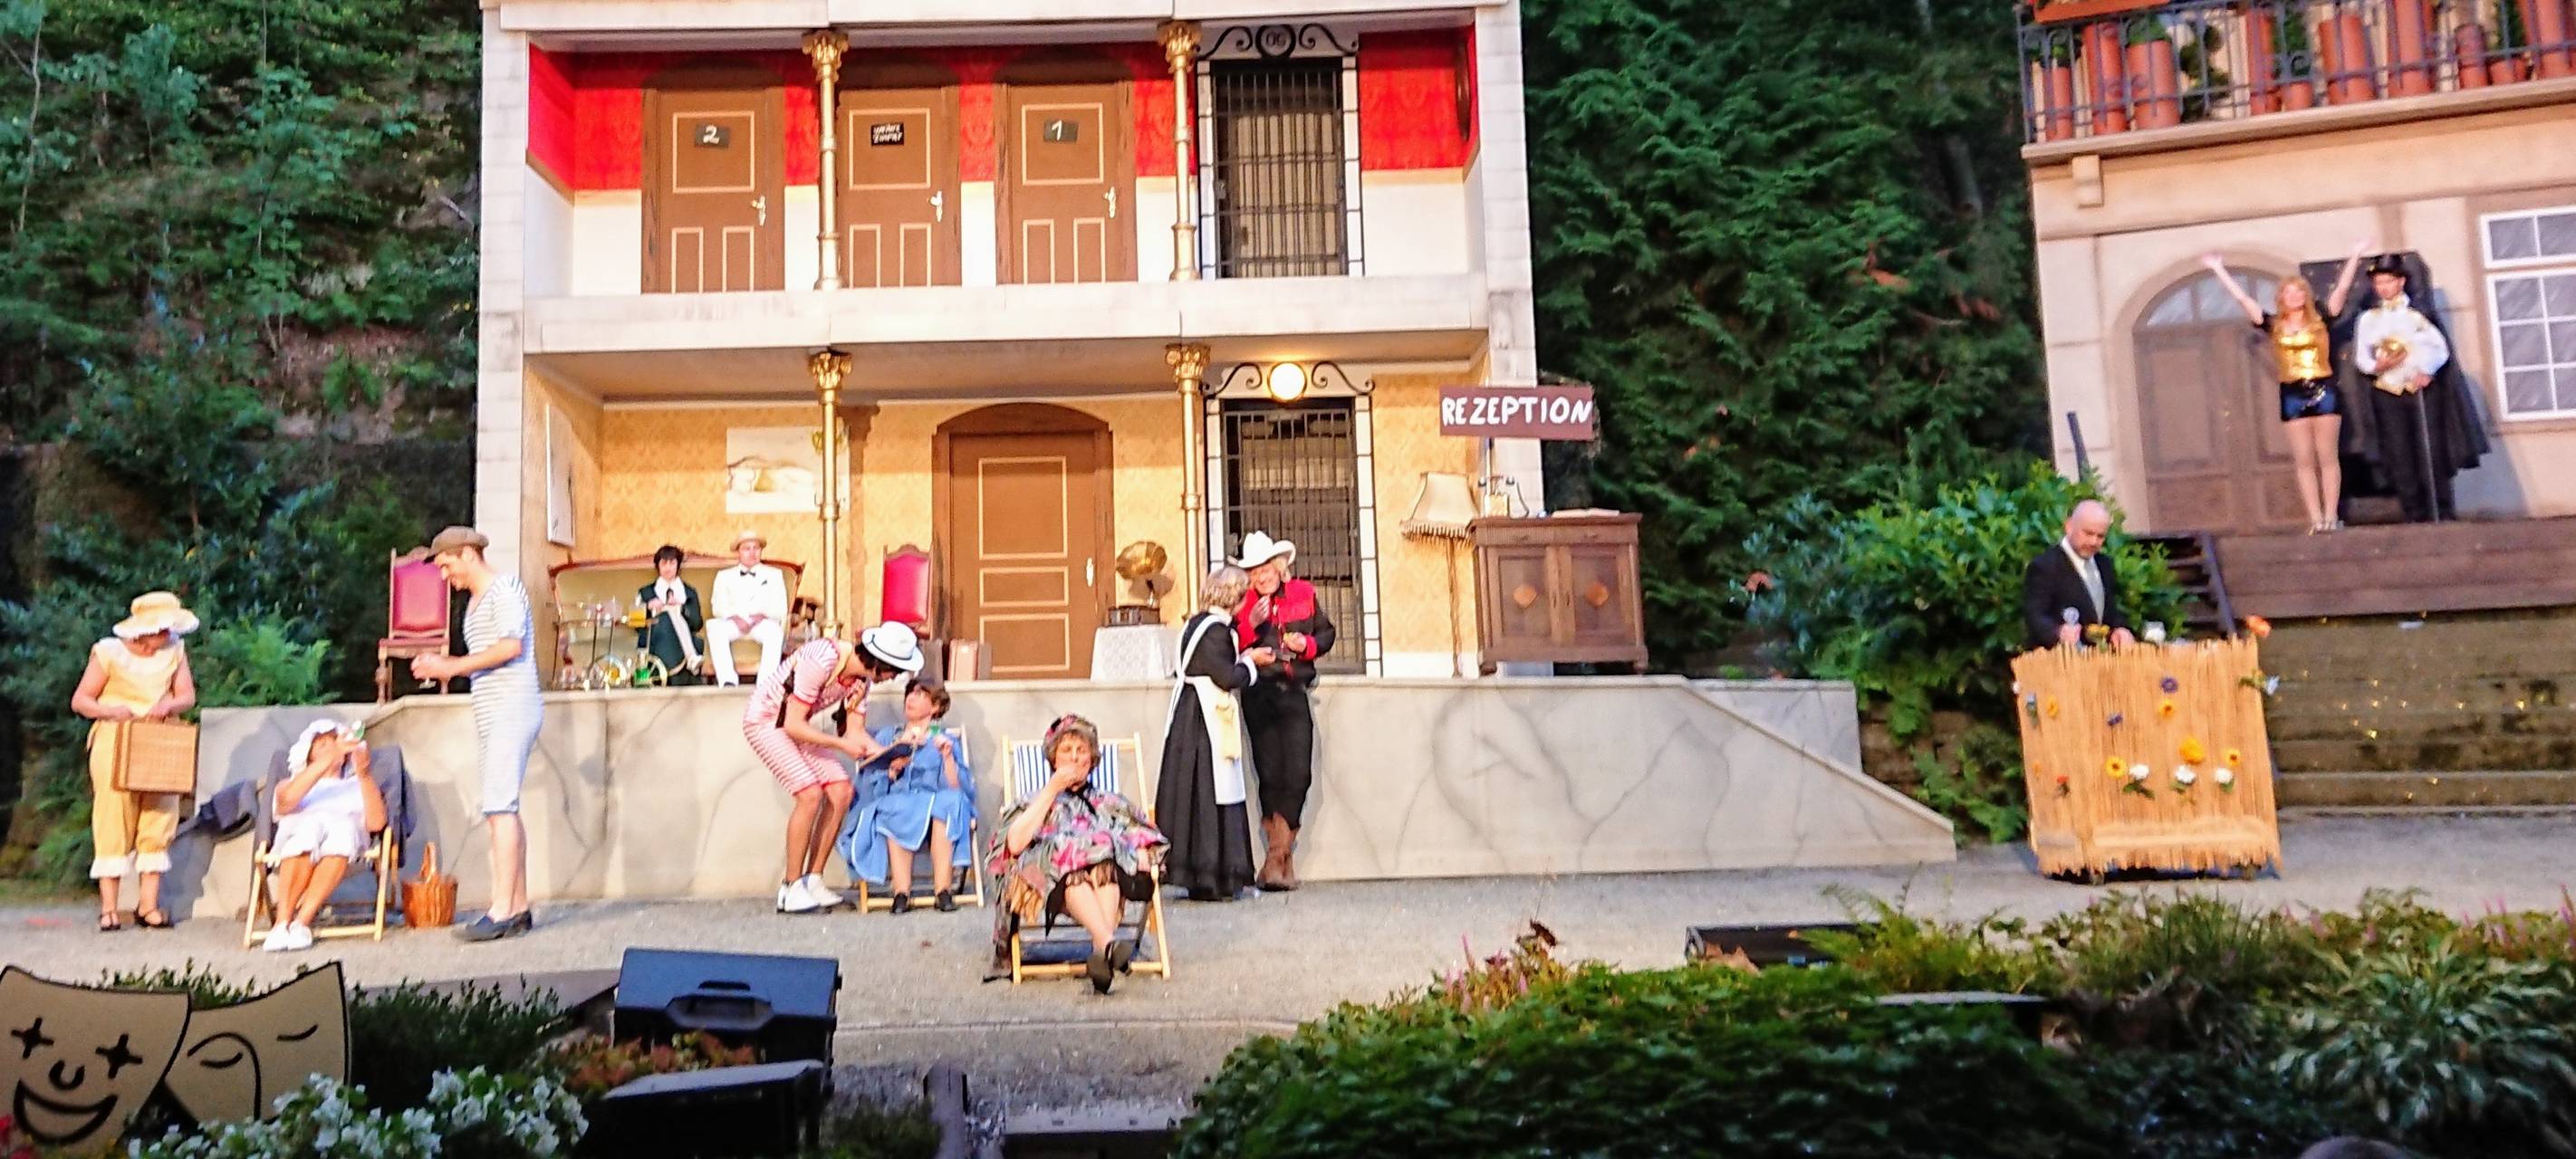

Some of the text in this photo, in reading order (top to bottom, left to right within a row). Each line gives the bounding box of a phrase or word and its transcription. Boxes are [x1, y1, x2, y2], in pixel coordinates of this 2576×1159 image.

[703, 125, 720, 145] 2
[1051, 120, 1062, 141] 1
[1441, 396, 1593, 426] REZEPTION
